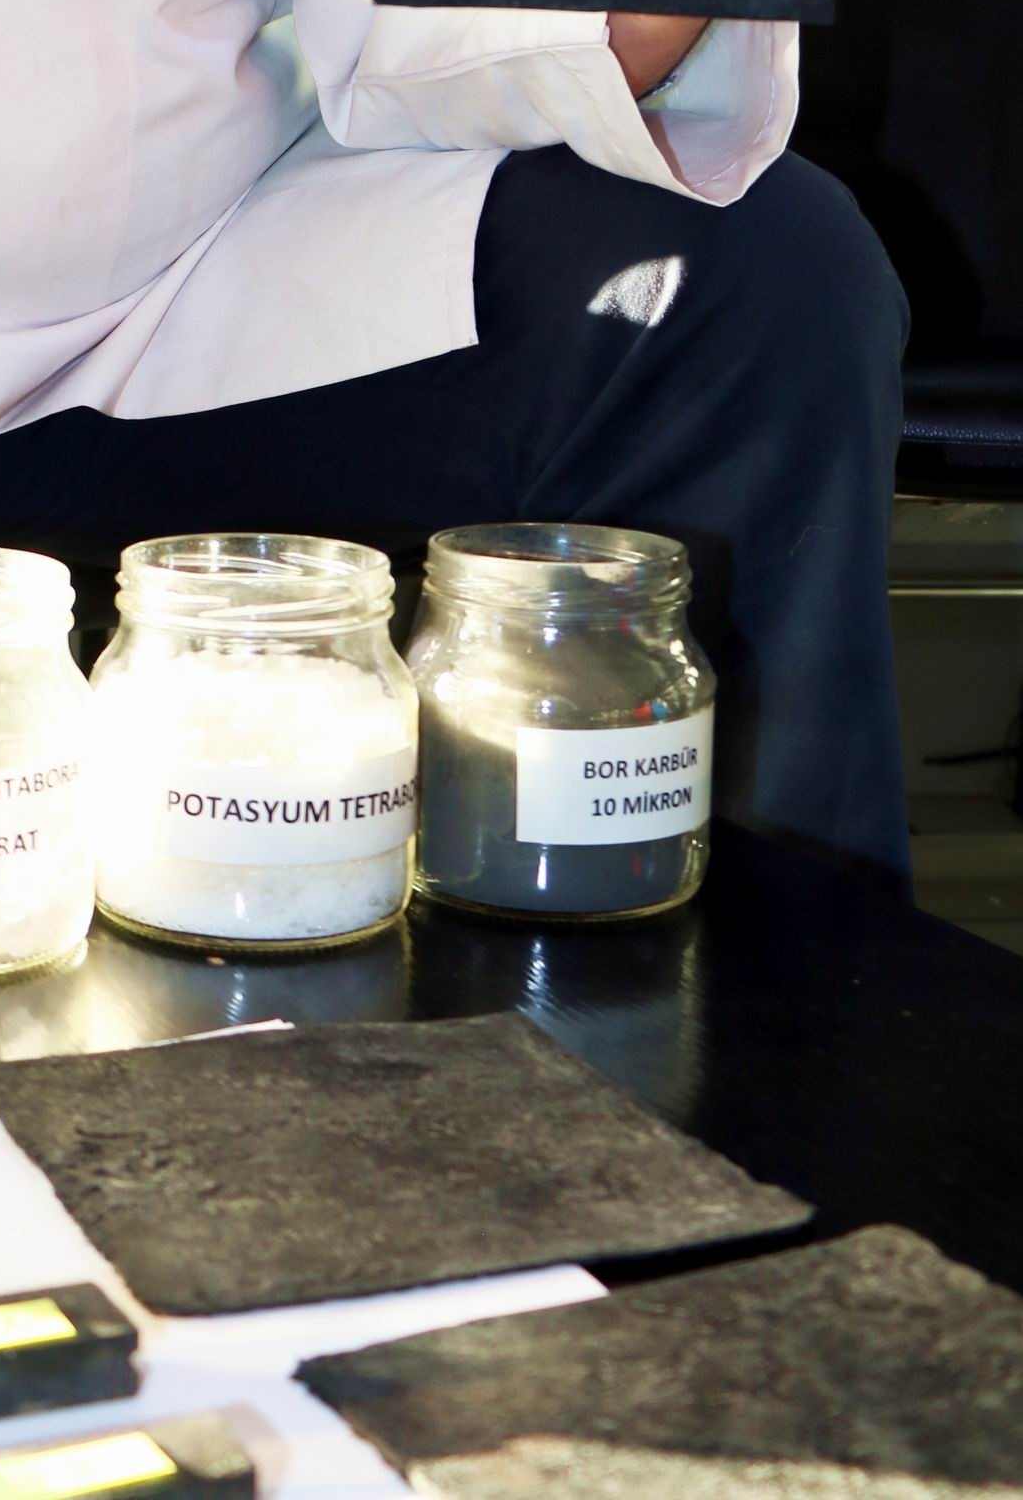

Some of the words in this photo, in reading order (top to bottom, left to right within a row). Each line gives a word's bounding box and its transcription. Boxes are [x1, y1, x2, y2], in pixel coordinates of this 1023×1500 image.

[584, 761, 628, 779] BOR
[635, 747, 698, 777] KARBÜR
[168, 790, 330, 824] POTASYUM
[592, 799, 616, 817] 10
[623, 786, 692, 815] MİKRON
